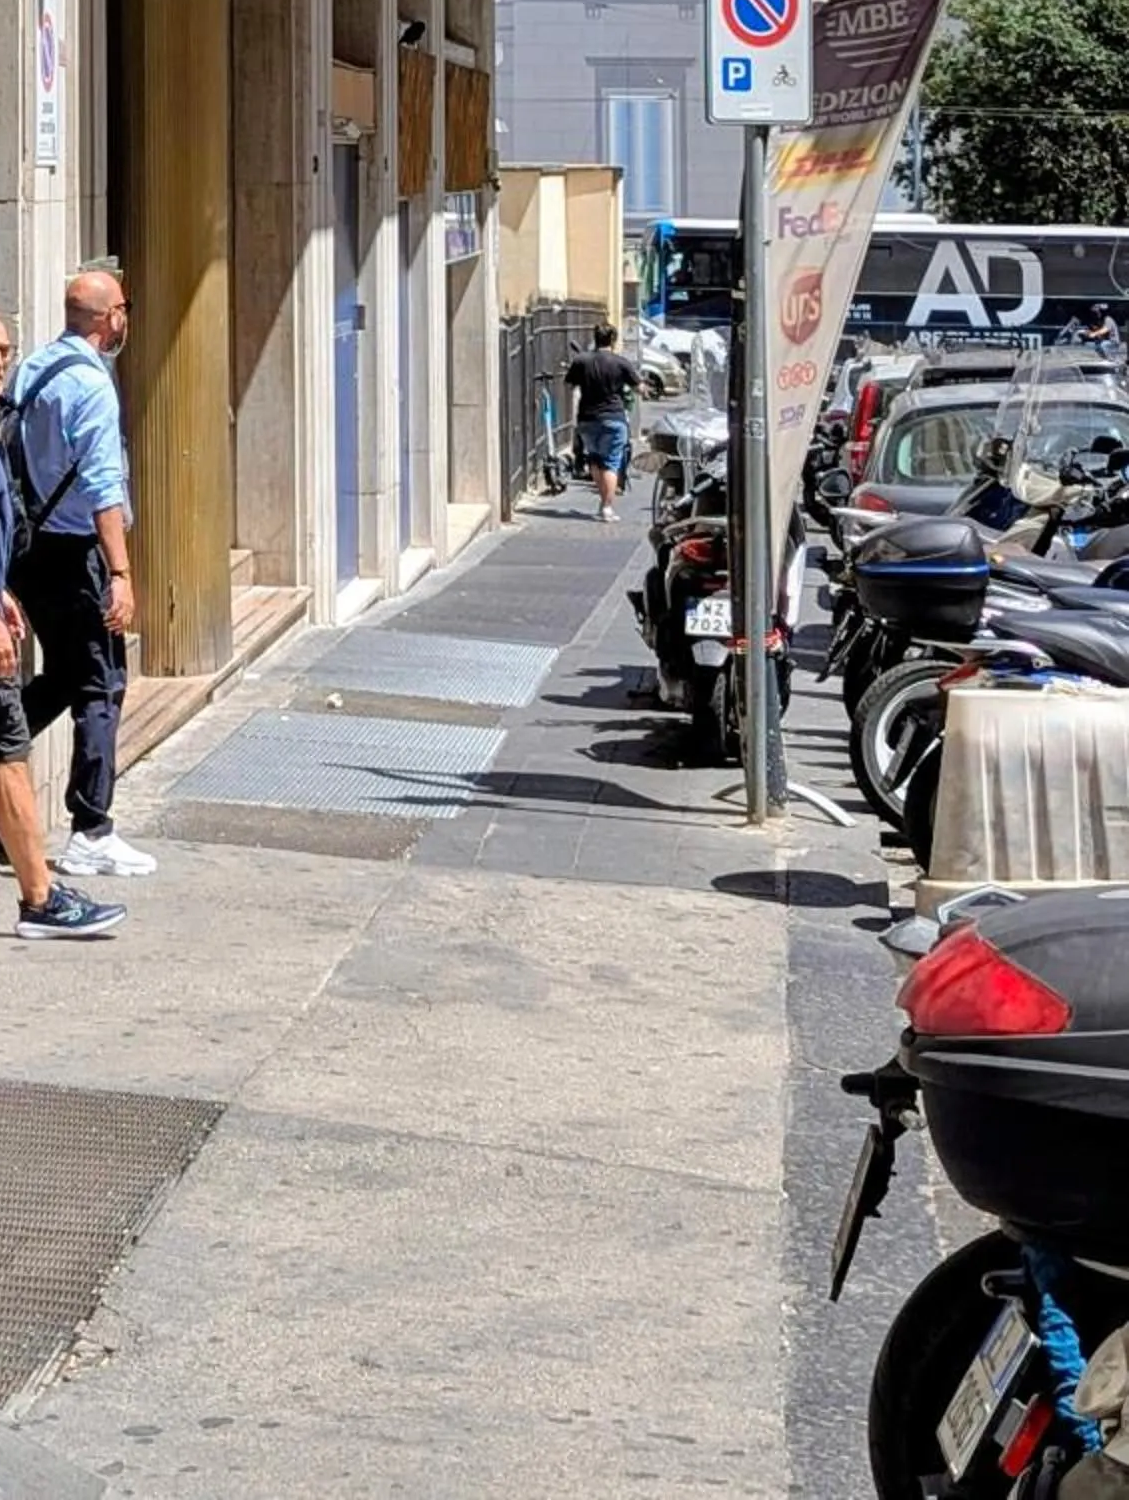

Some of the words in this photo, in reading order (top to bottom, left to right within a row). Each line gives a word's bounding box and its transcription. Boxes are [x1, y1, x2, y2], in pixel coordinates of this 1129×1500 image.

[837, 0, 910, 37] MBE
[728, 61, 746, 88] P
[905, 239, 1044, 327] AD
